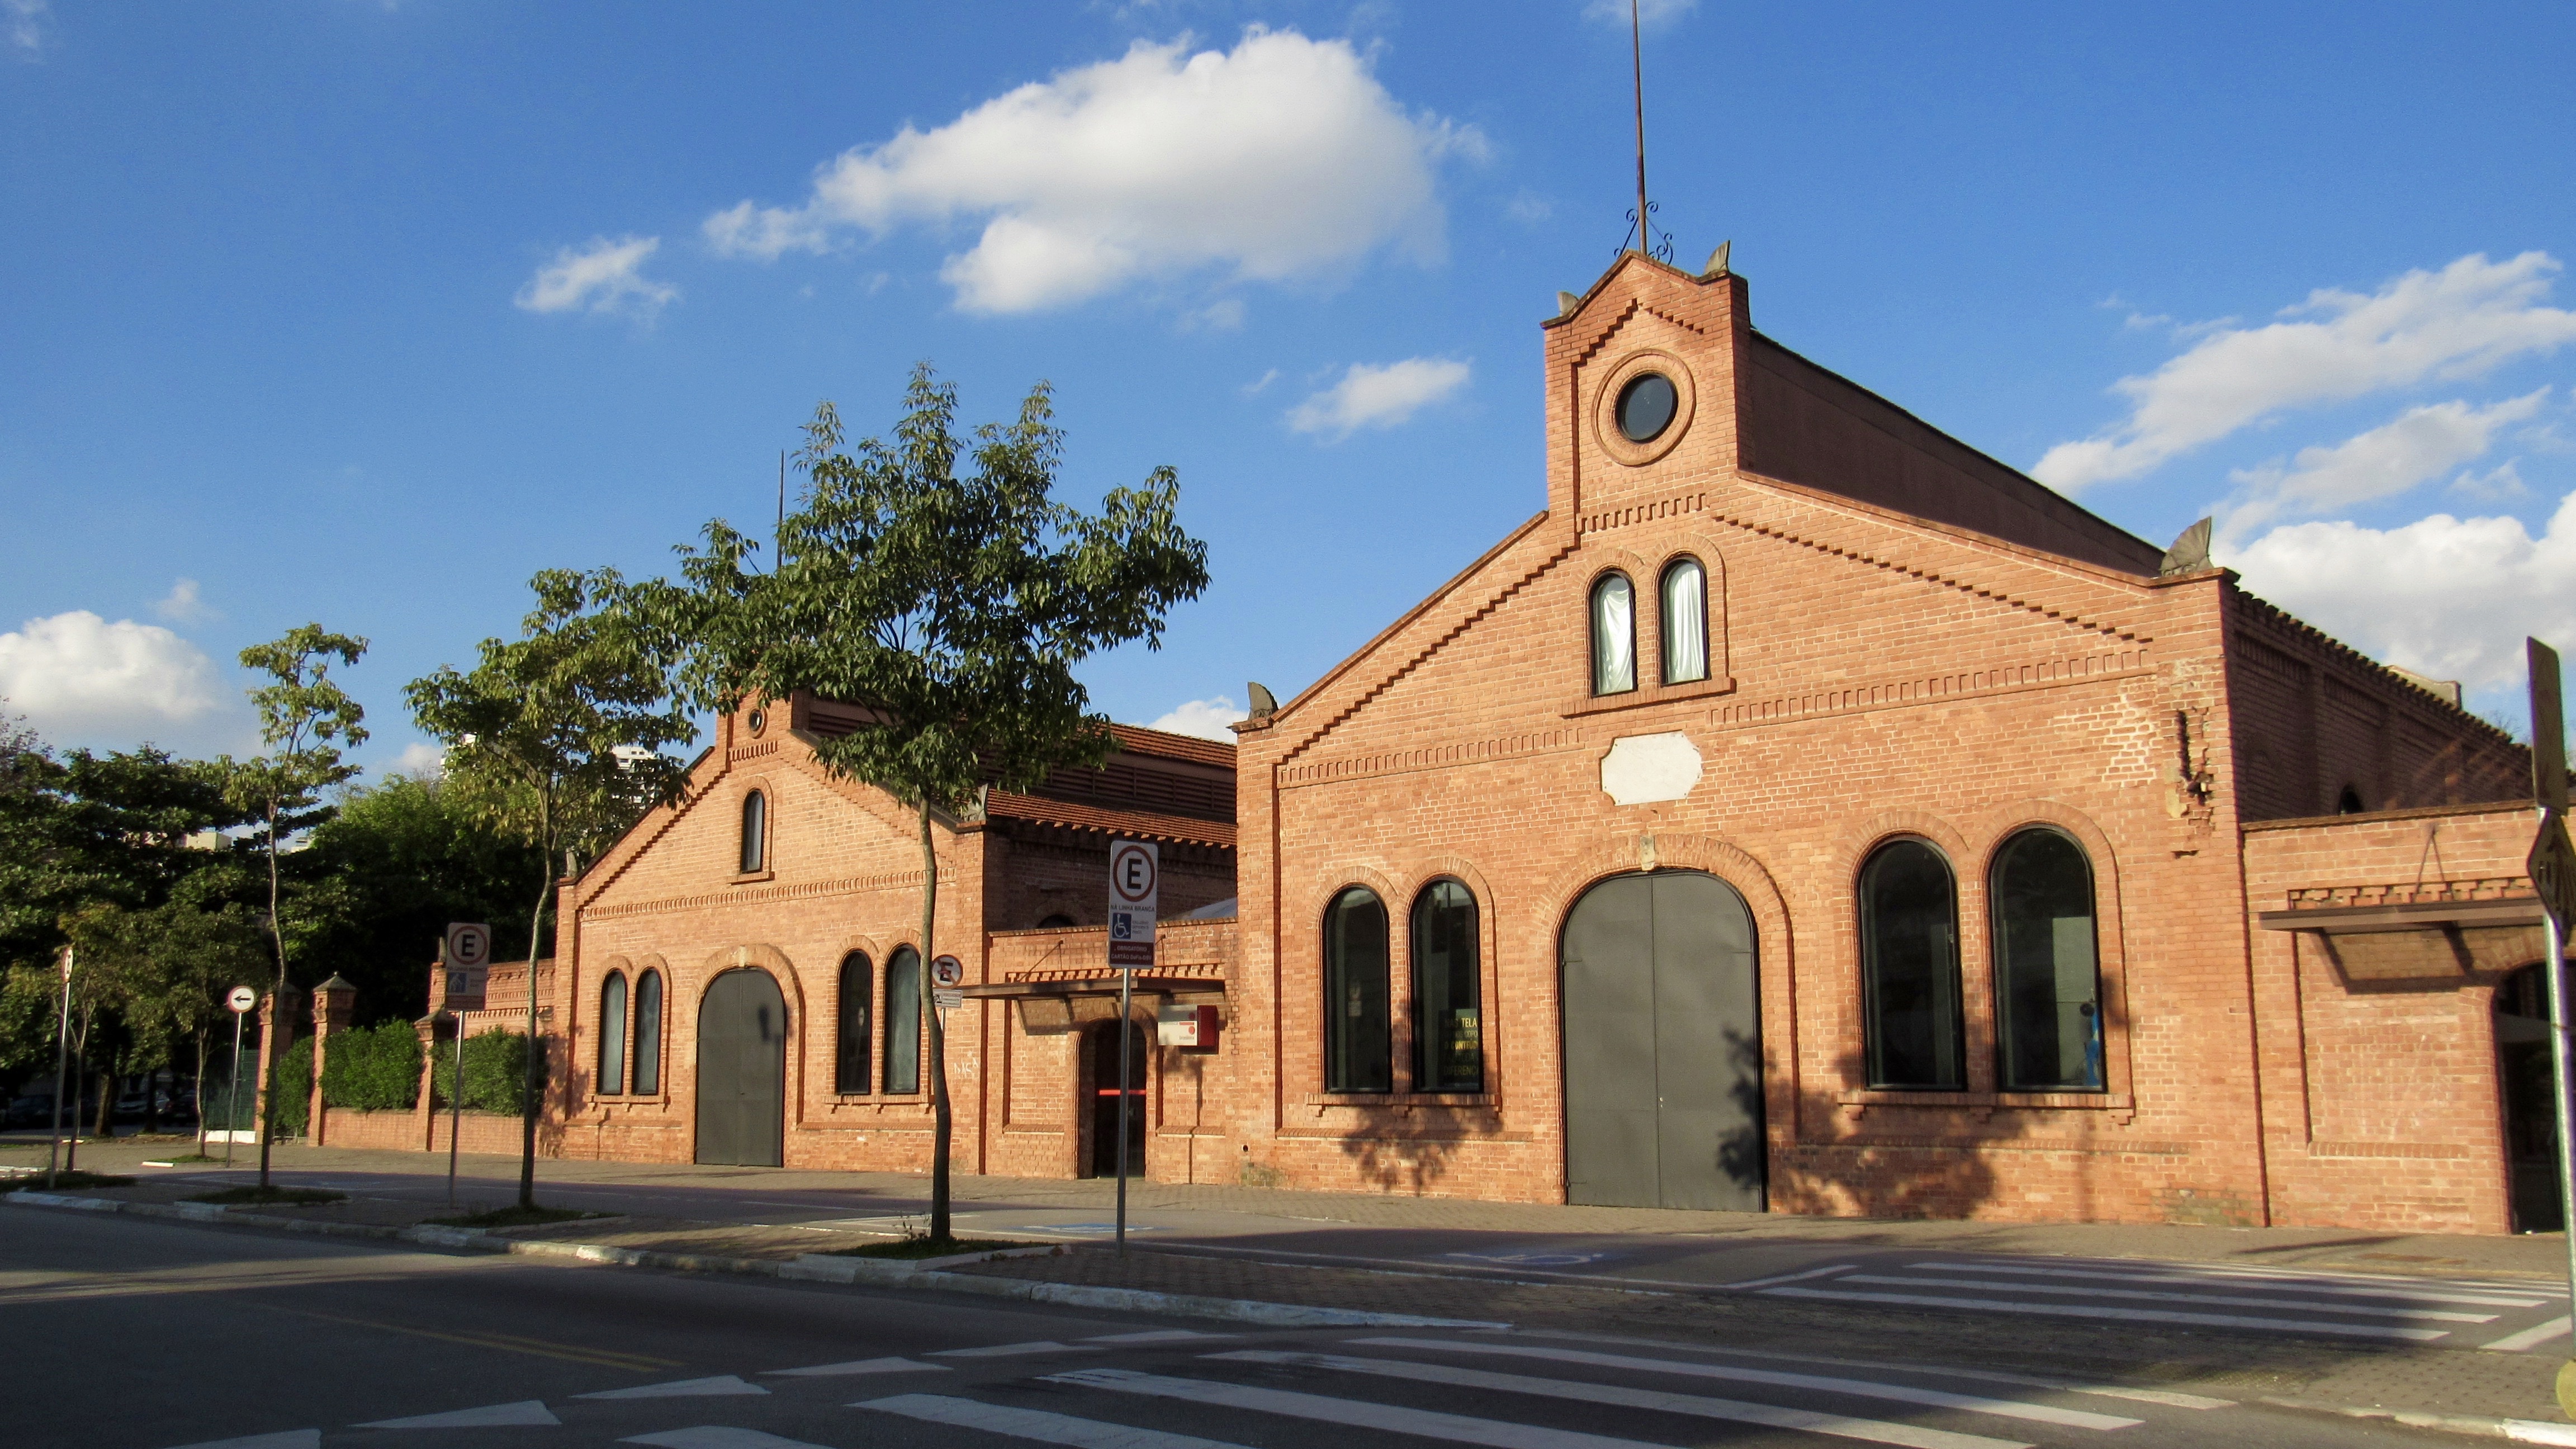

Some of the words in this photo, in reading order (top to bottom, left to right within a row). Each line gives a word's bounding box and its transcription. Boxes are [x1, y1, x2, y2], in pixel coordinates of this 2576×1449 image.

[1127, 858, 1142, 889] E
[462, 934, 476, 956] E
[1461, 1017, 1477, 1027] TELA
[1451, 1038, 1478, 1050] CONTEÚD
